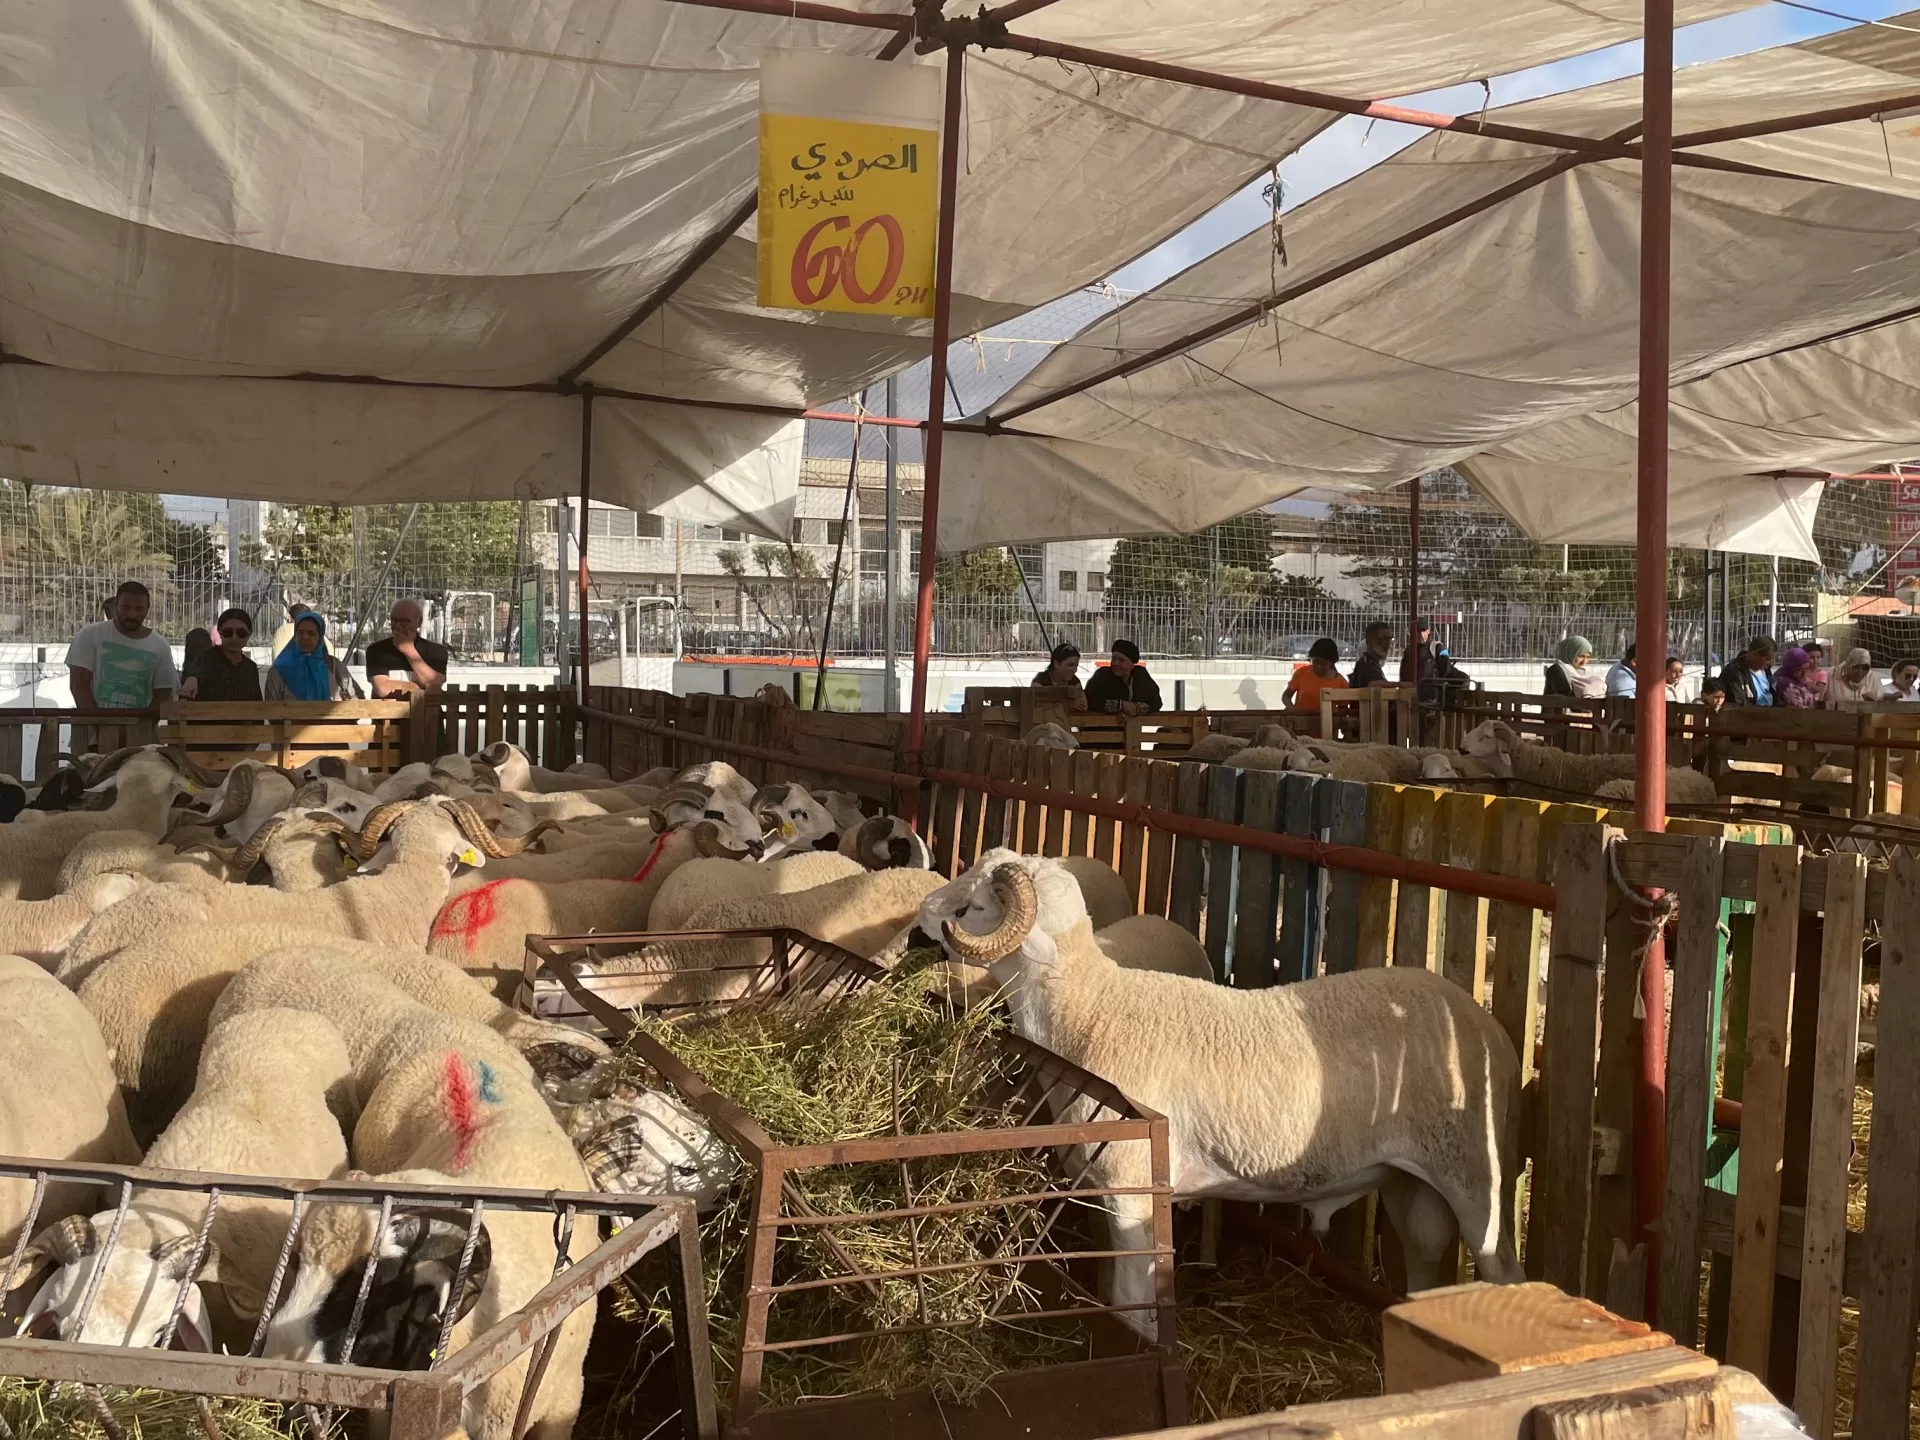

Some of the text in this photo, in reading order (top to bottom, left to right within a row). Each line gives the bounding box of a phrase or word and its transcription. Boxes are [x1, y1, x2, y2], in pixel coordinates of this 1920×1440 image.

[790, 142, 918, 181] الصردي
[790, 214, 905, 306] 60
[1902, 485, 1920, 500] Se
